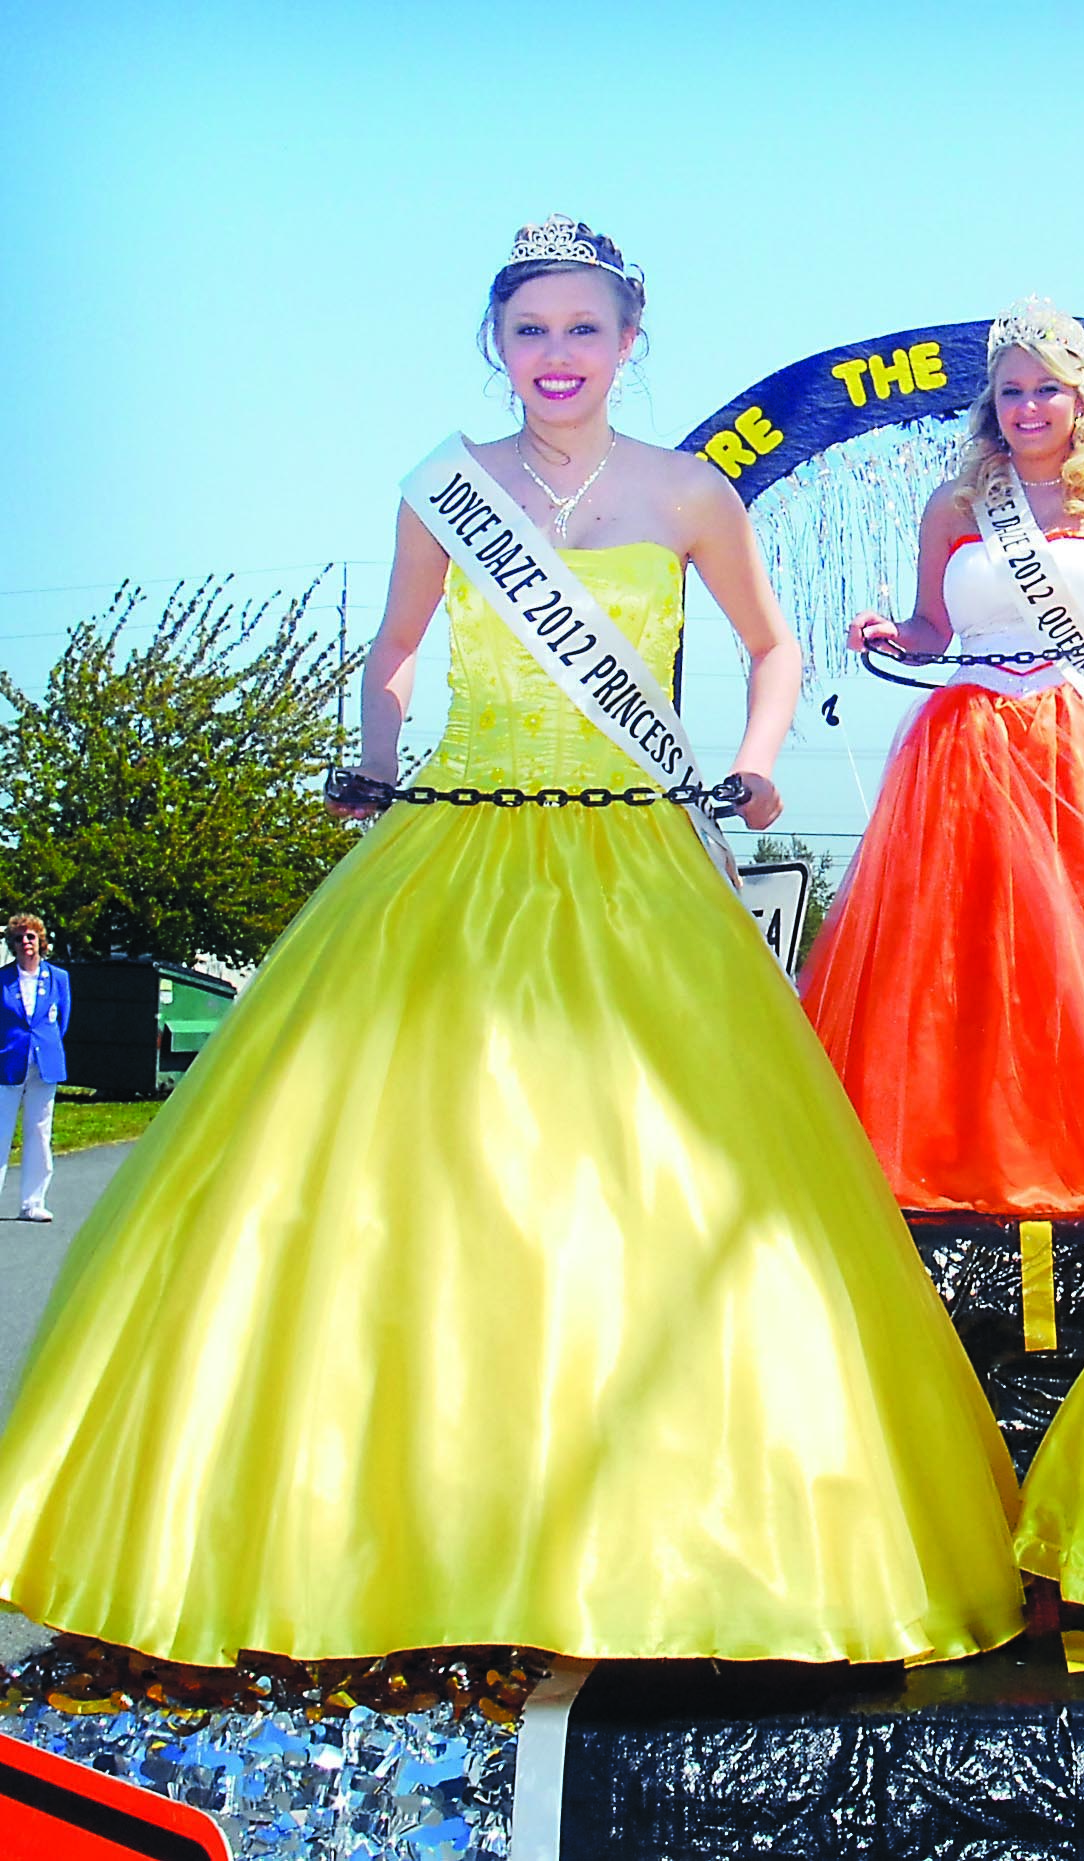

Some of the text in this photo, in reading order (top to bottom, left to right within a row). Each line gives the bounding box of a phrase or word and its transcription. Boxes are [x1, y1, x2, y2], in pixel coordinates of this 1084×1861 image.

[695, 405, 785, 479] RE
[831, 341, 947, 407] THE
[429, 473, 682, 774] JOYCE DAZE 2012 PRINCESS
[1008, 550, 1054, 604] 2012
